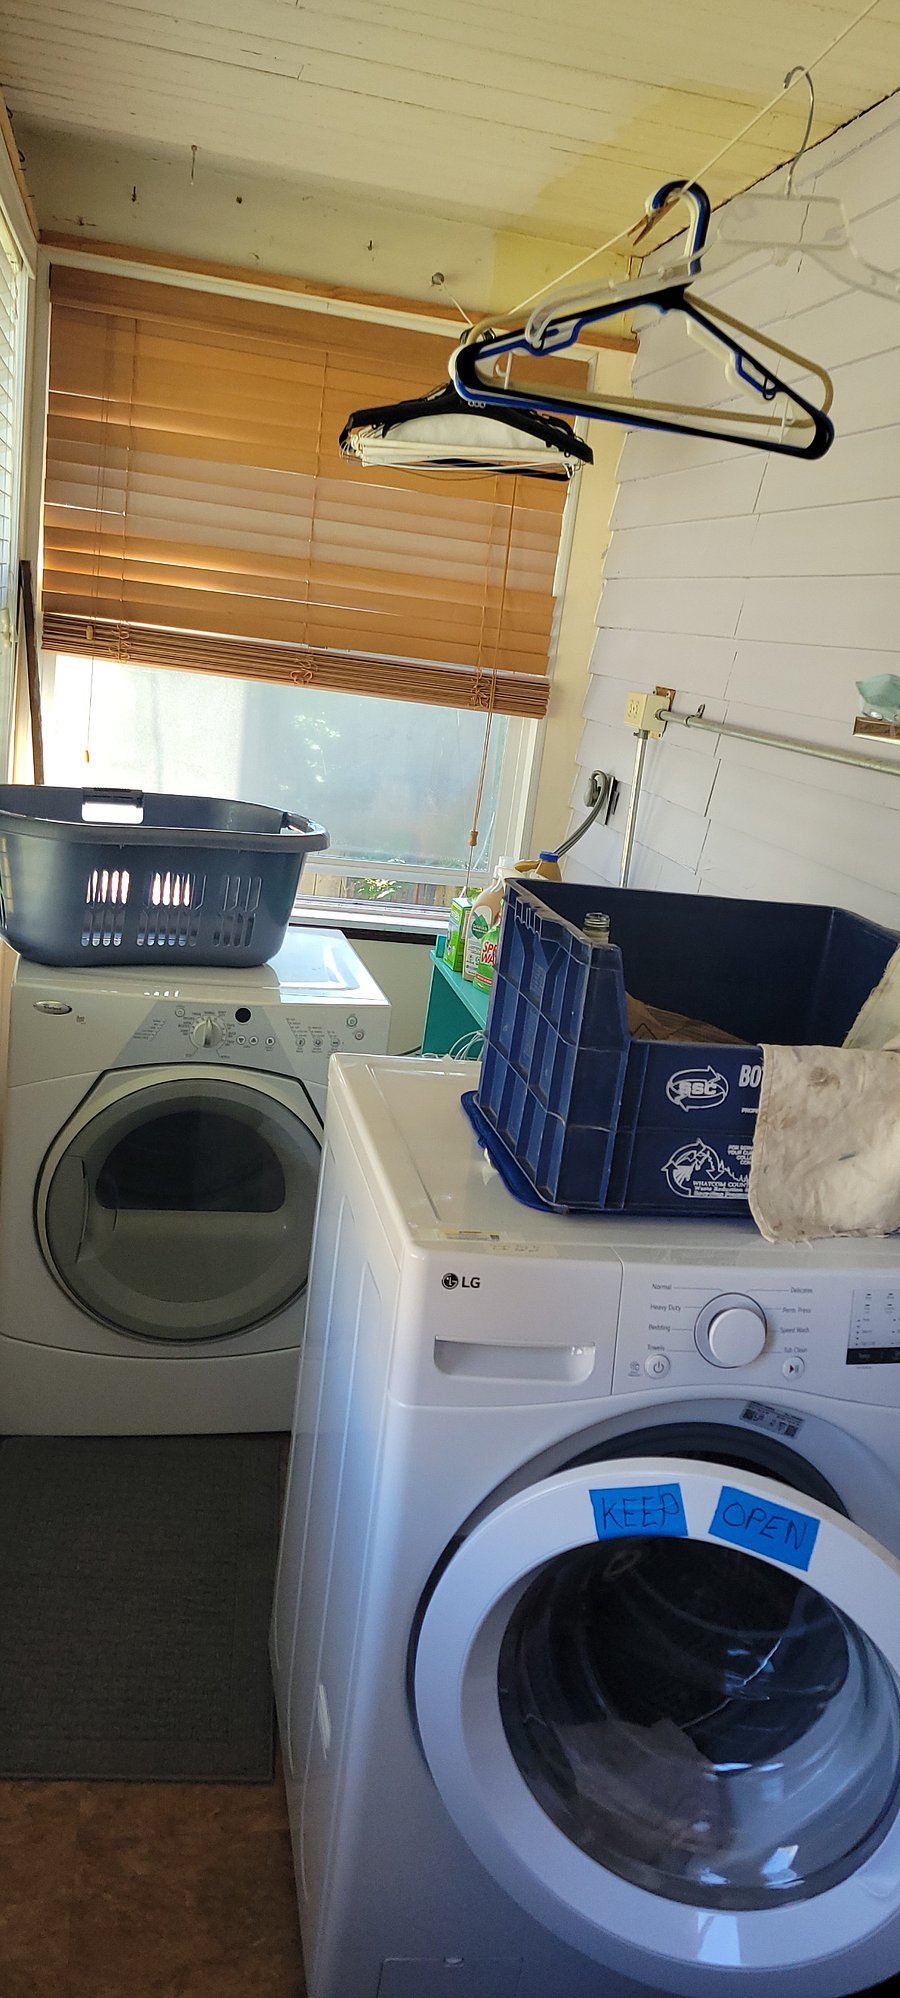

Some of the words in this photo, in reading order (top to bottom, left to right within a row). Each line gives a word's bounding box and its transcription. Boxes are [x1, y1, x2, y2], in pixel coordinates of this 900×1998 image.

[461, 1276, 481, 1288] LG
[648, 1324, 671, 1332] Bedding
[601, 1493, 680, 1530] KEEP
[722, 1502, 807, 1550] OPEN
